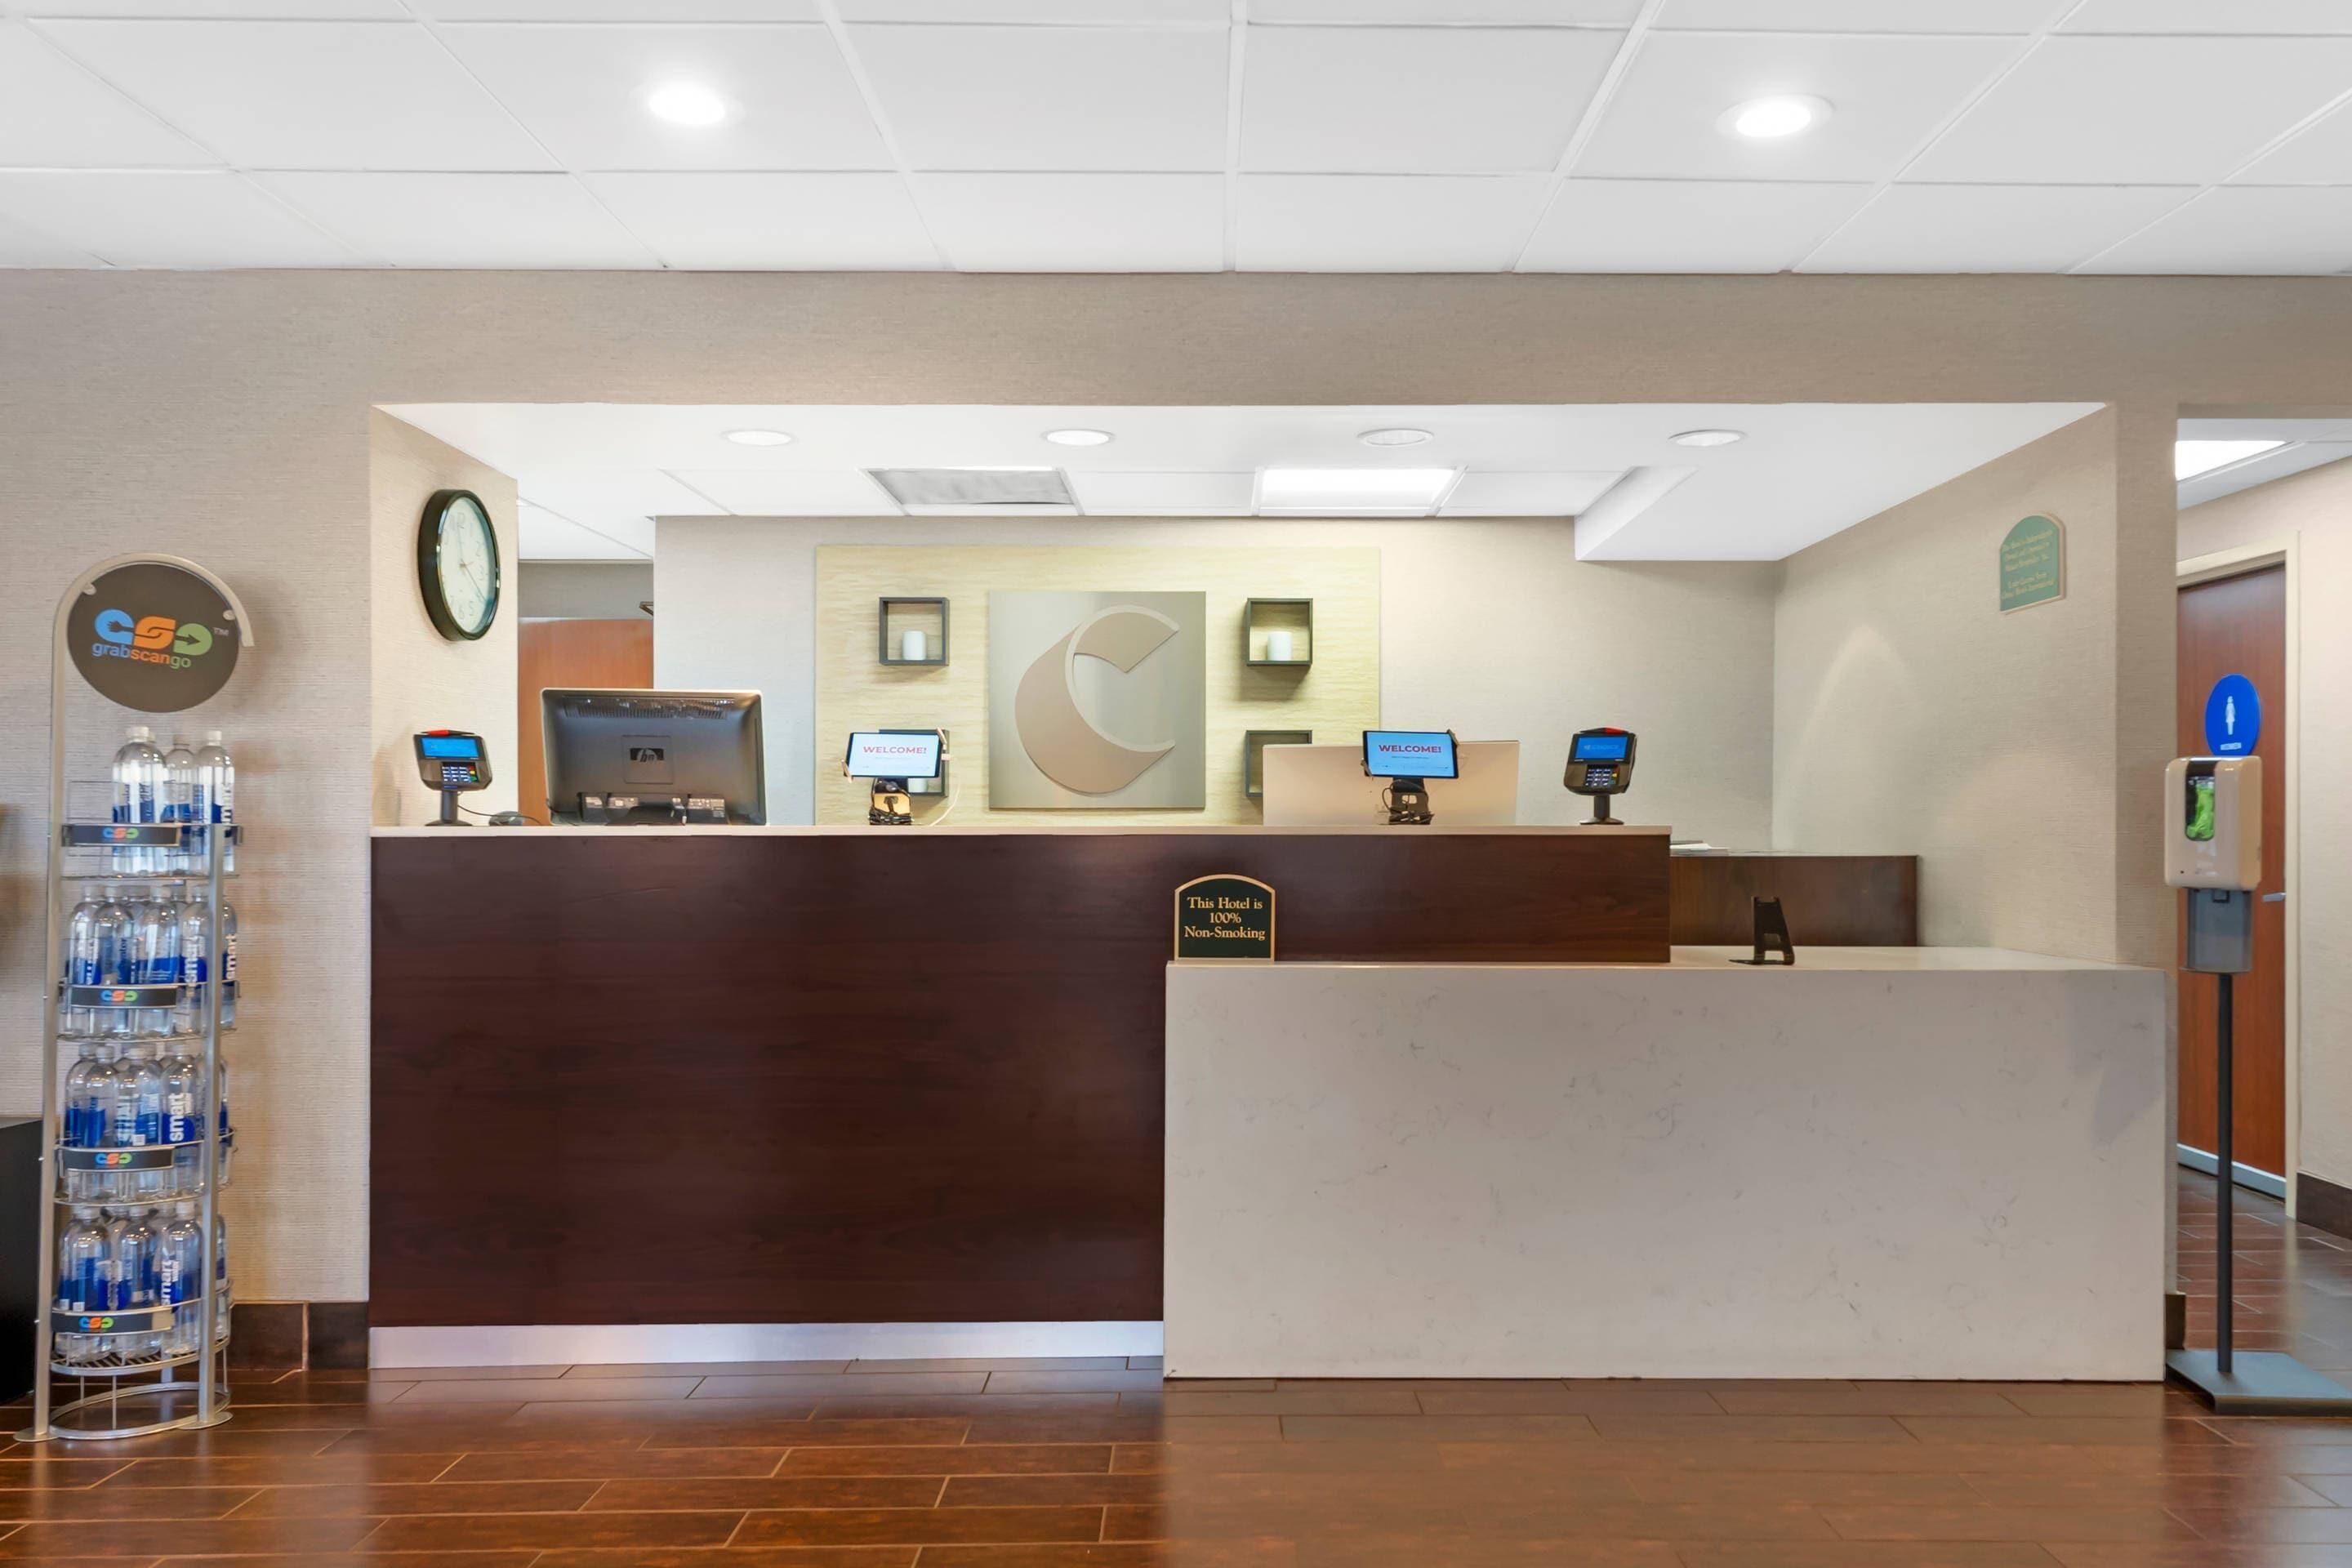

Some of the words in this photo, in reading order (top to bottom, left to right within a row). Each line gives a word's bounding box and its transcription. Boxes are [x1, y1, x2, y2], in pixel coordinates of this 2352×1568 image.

[91, 643, 192, 669] grabscango
[863, 746, 928, 754] WELCOME!
[1378, 744, 1442, 753] WELCOME!
[1187, 897, 1214, 909] This
[1218, 897, 1250, 909] Hotel
[1254, 898, 1263, 909] is
[1209, 911, 1241, 924] 100%
[1183, 925, 1266, 941] Non-Smoking
[169, 1093, 185, 1141] smart
